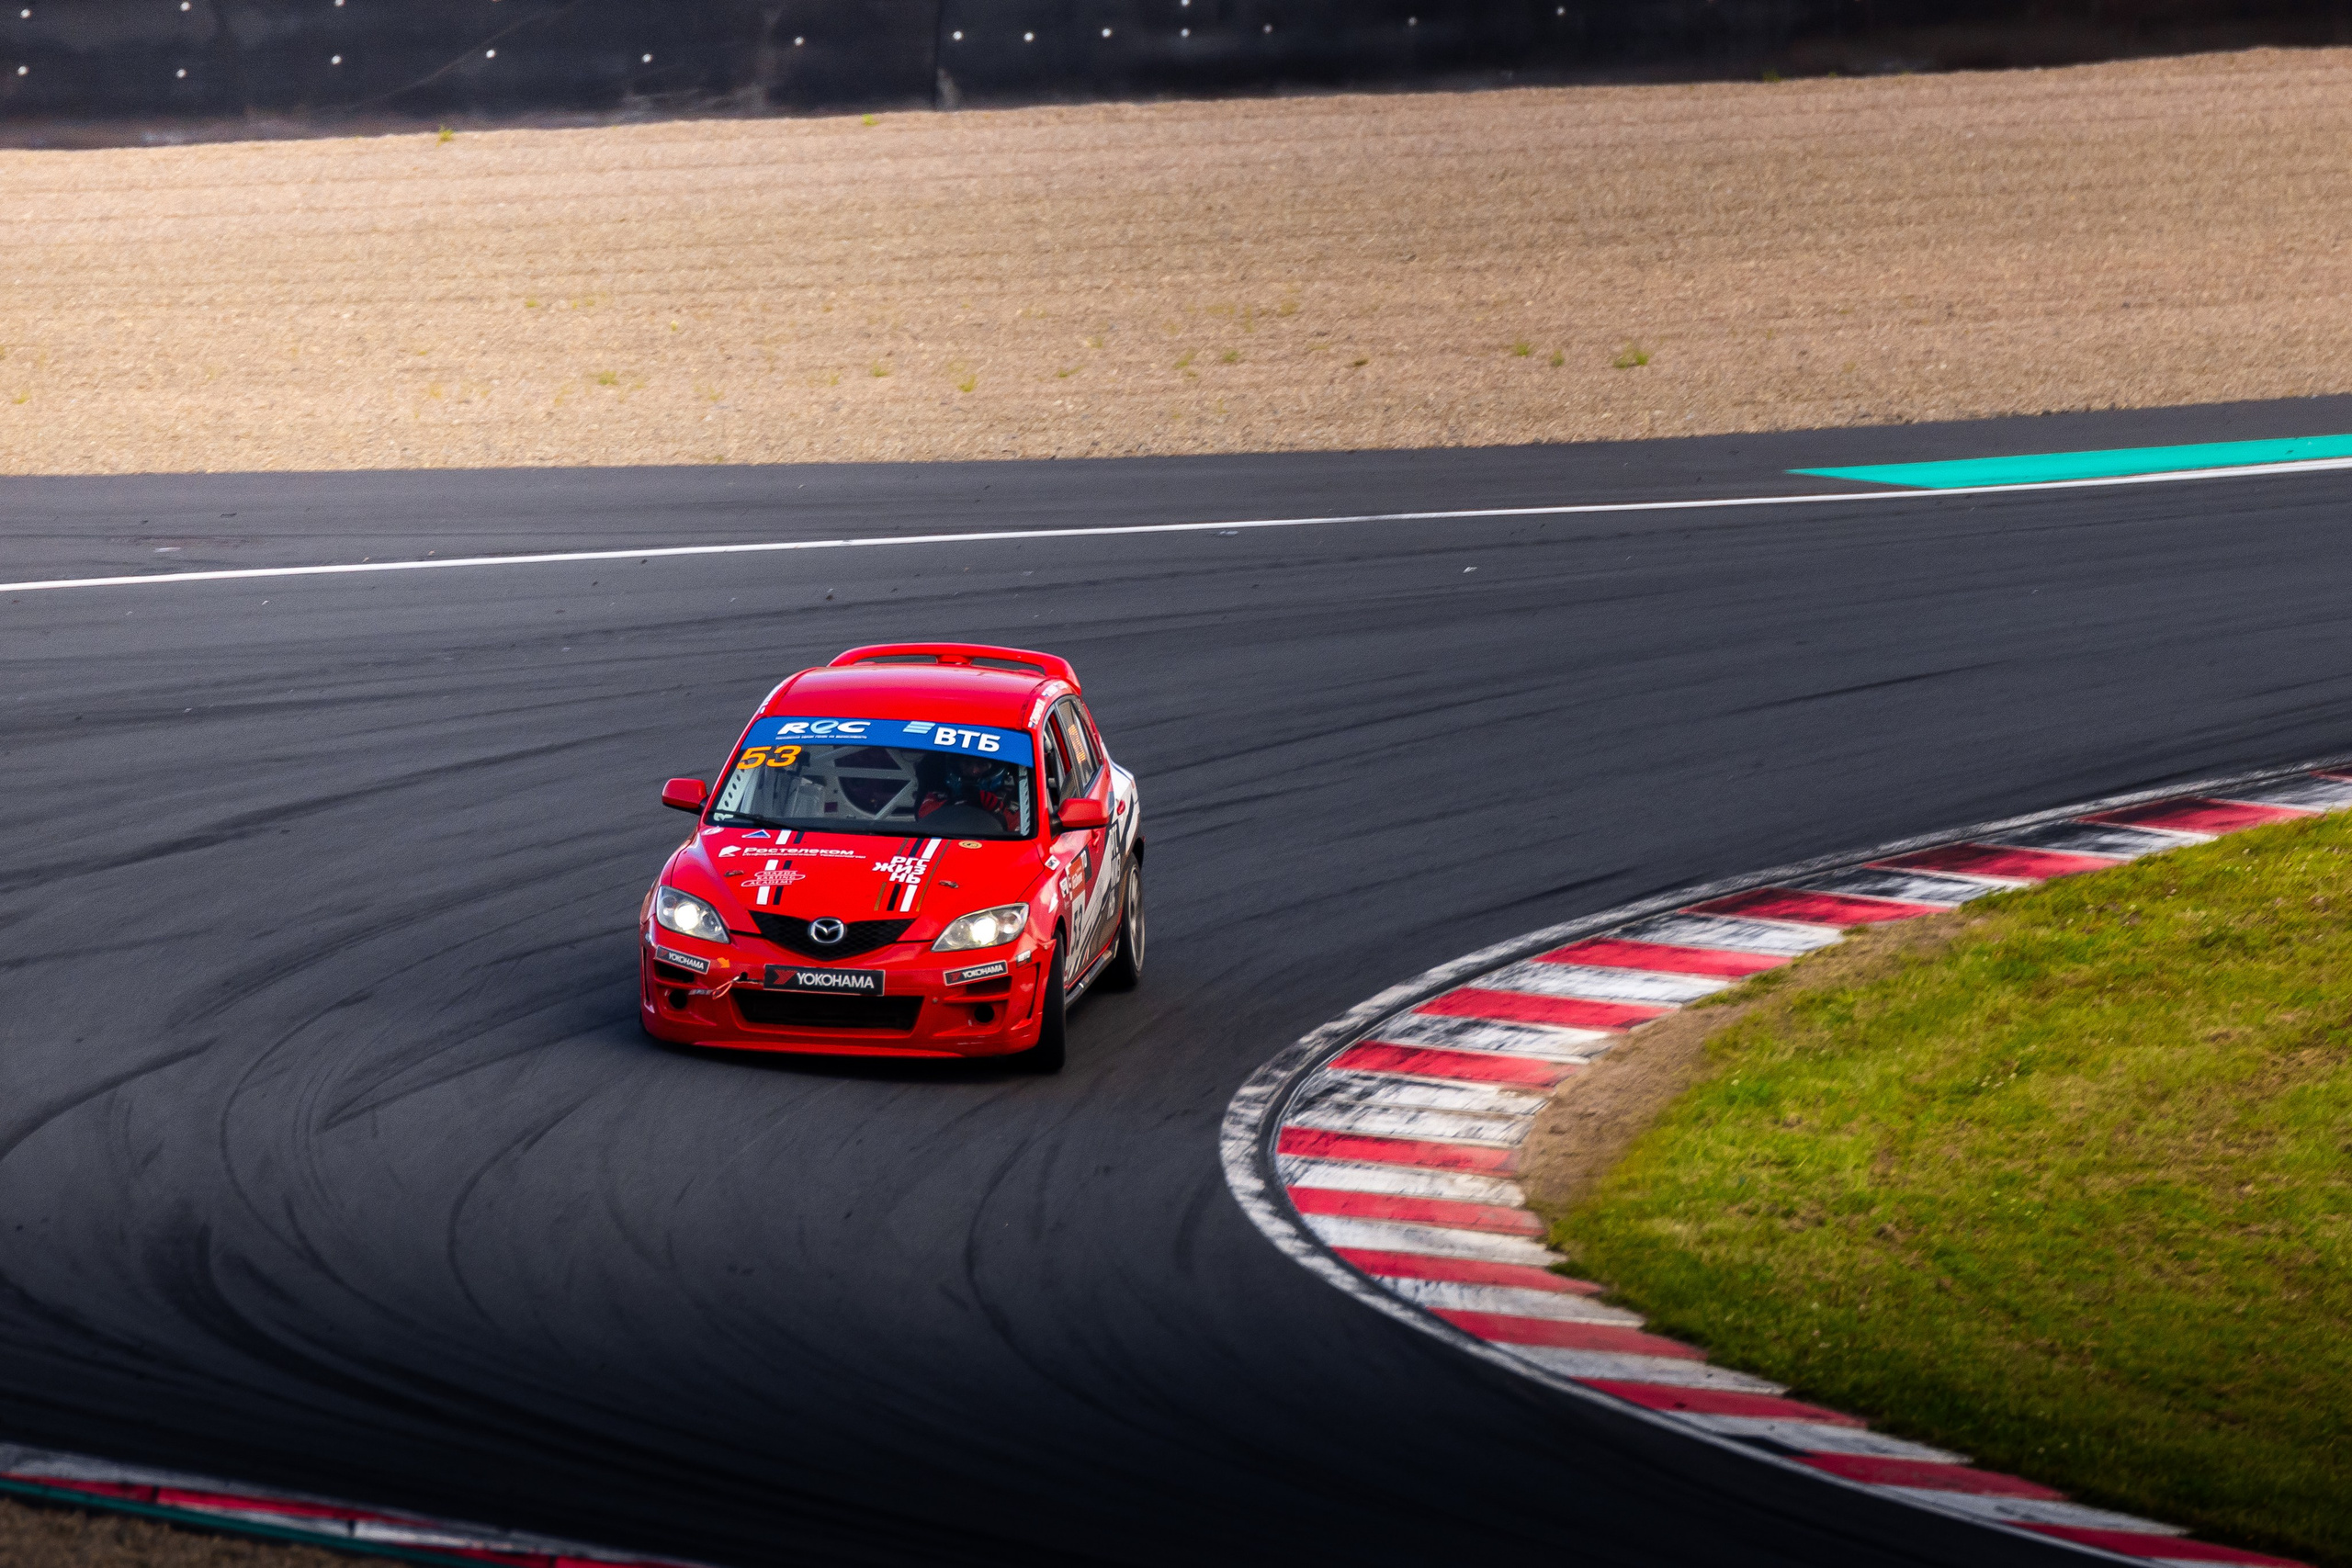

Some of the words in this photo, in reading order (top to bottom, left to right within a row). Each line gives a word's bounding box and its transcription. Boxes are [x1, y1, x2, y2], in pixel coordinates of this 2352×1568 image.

[934, 727, 1001, 752] ВТБ
[736, 745, 802, 770] 53
[743, 847, 854, 855] Ростелеком
[872, 862, 926, 875] ЖИЗ
[890, 855, 930, 868] РГС
[889, 873, 921, 884] НЬ
[668, 952, 705, 970] YOKOHAMA
[962, 964, 1004, 978] YOKOHAMA
[796, 972, 875, 989] YOKOHAMA
